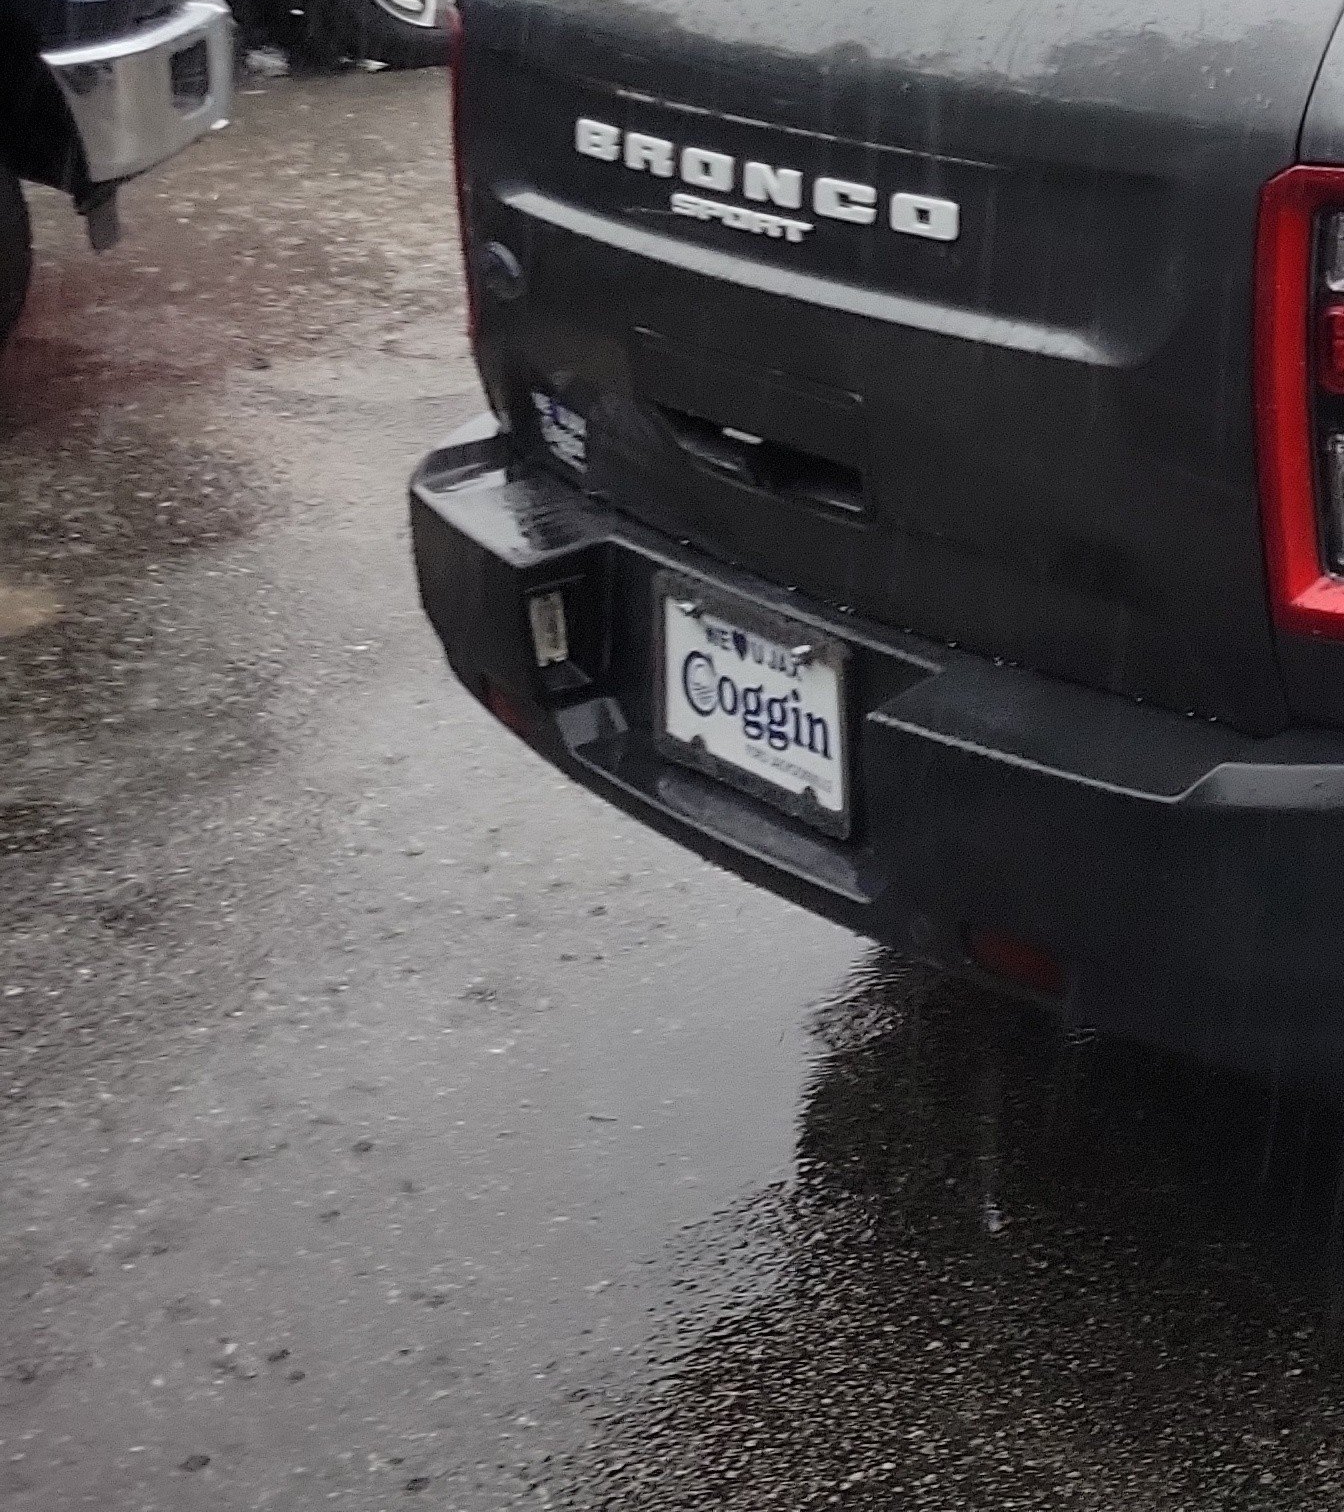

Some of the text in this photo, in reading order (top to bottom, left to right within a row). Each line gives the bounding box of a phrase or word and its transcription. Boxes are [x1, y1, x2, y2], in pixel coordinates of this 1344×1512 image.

[575, 118, 959, 241] BRONCO
[670, 193, 814, 242] SPORT
[682, 650, 832, 760] Coggin
